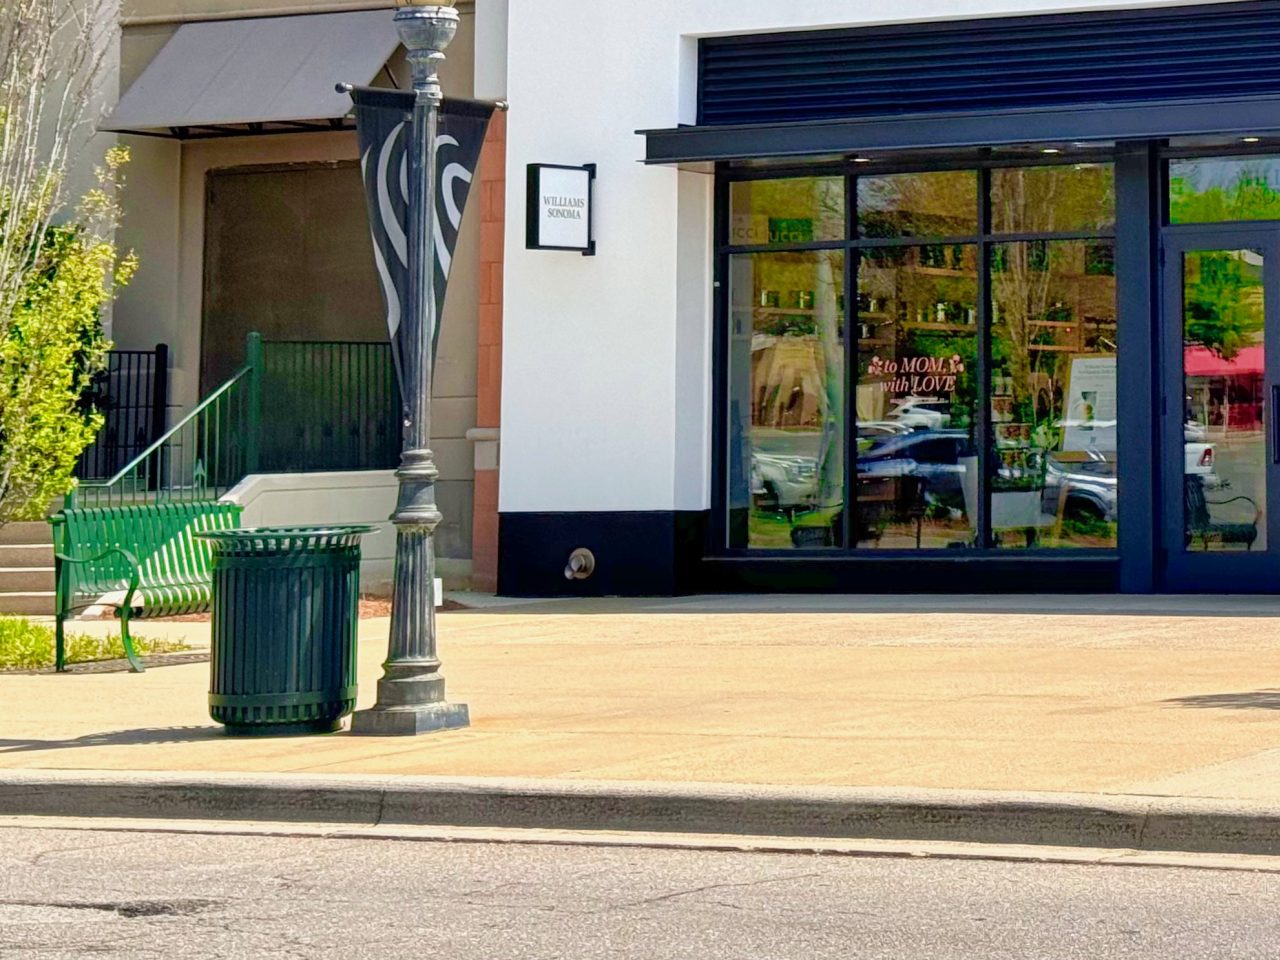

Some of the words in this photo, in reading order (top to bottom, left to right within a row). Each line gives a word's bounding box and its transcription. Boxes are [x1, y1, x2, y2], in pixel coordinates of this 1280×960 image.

[543, 196, 584, 208] WILLIAMS
[547, 208, 581, 219] SONOMA
[884, 358, 898, 373] to
[900, 357, 946, 373] MOM,
[880, 375, 909, 392] with
[912, 375, 957, 392] LOVE
